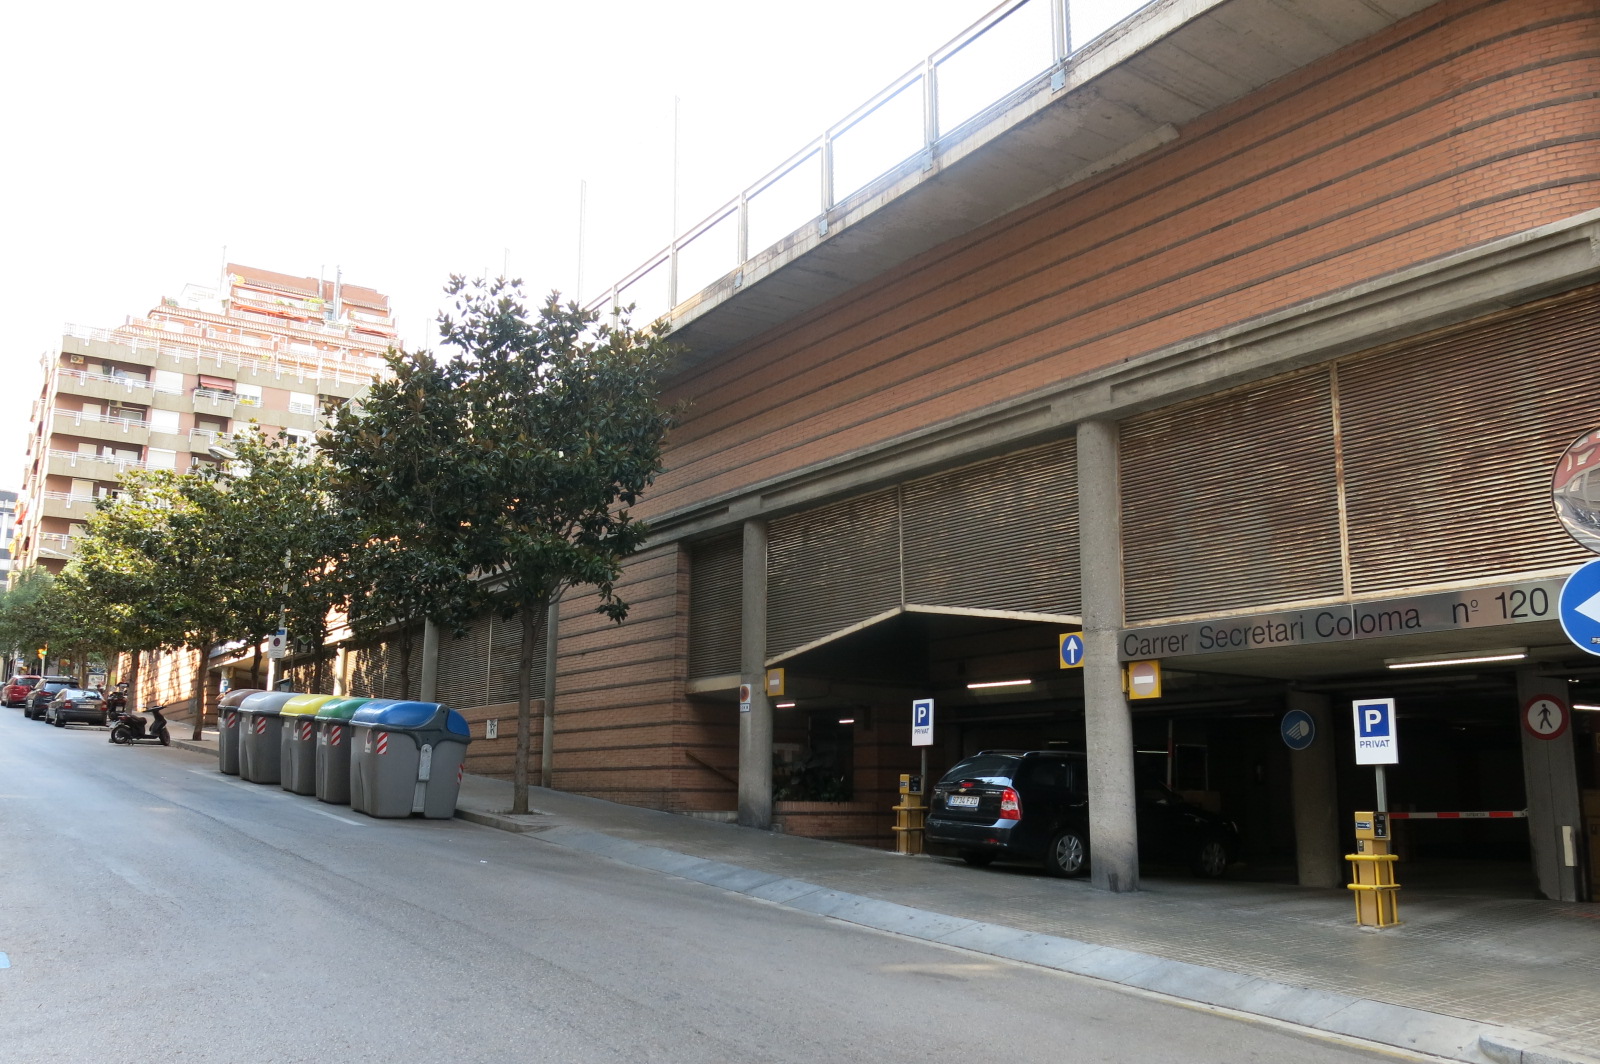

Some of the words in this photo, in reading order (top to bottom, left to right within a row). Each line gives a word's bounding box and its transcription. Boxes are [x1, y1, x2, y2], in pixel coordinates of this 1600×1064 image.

[1123, 633, 1189, 657] Carrer
[1199, 614, 1305, 650] Secretari
[1315, 608, 1422, 638] Coloma
[1495, 587, 1549, 619] 120
[918, 707, 927, 723] P
[1364, 709, 1382, 733] P
[1359, 739, 1391, 748] PRIVAT
